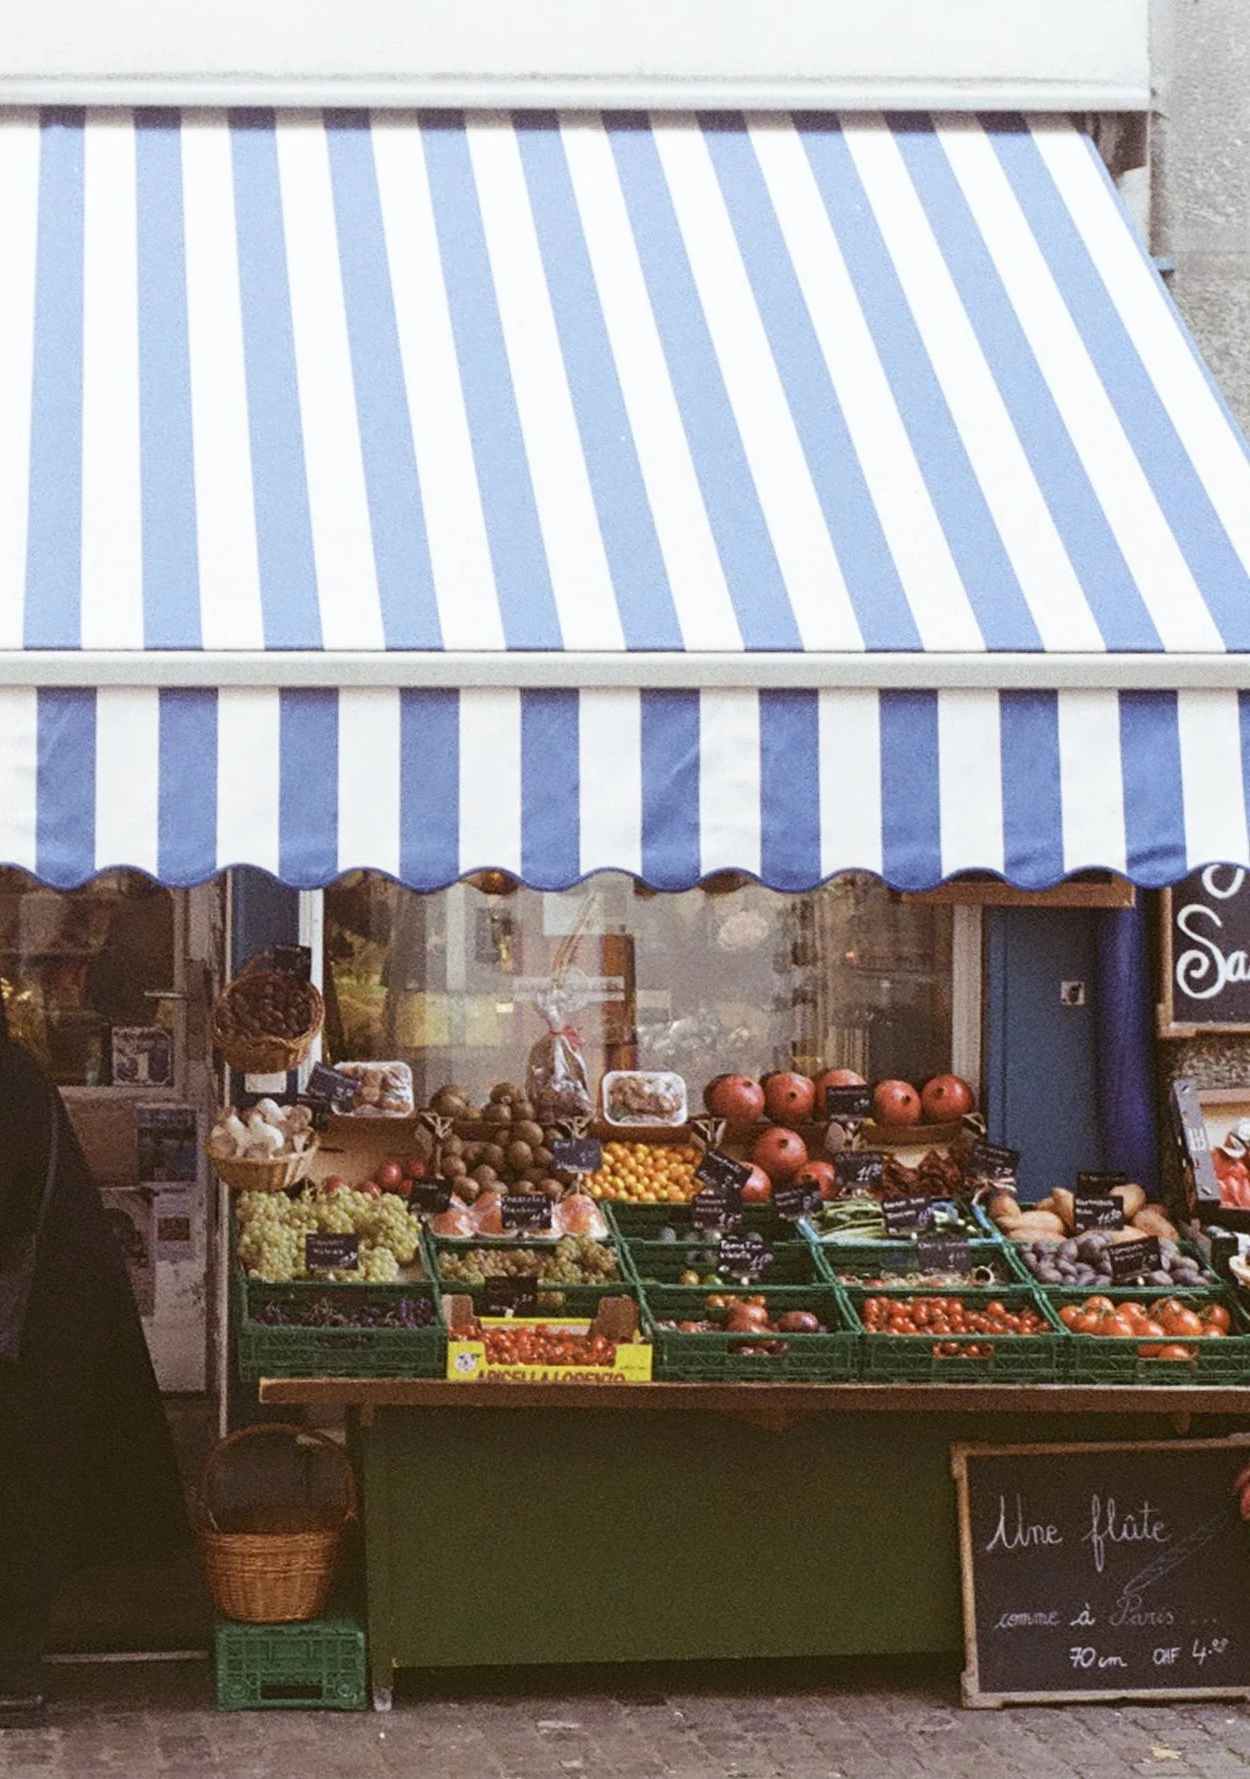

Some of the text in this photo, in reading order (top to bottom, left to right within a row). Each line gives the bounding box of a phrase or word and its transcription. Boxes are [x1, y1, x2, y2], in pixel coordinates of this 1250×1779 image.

[987, 1493, 1168, 1573] Une flûte
[995, 1610, 1061, 1628] comme
[1070, 1603, 1096, 1627] à
